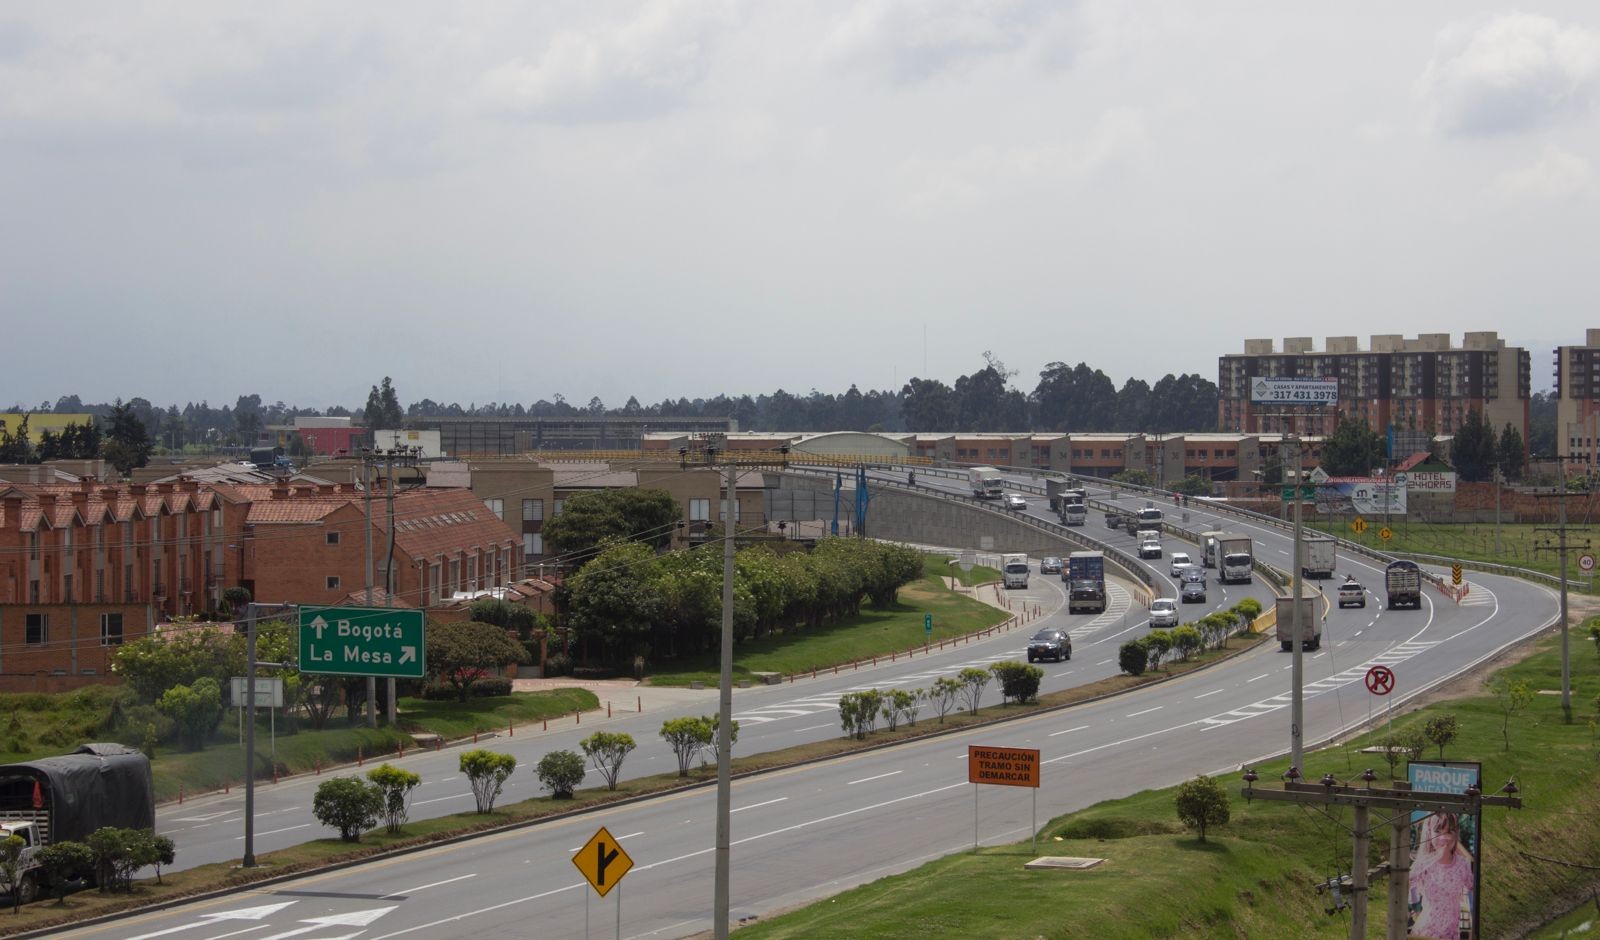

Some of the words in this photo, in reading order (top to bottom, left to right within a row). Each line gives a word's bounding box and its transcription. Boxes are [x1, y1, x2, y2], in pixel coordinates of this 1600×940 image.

[1273, 391, 1291, 399] 317
[1293, 391, 1311, 399] 431
[1314, 391, 1337, 400] 3978
[337, 619, 403, 642] Bogotá
[310, 643, 333, 661] La
[344, 645, 392, 664] Mesa
[974, 750, 1035, 762] PRECAUCIÓN
[979, 760, 1012, 770] TRAMO
[1014, 763, 1031, 772] SIN
[979, 771, 1031, 782] DEMARCAR
[1415, 769, 1471, 788] PARQUE
